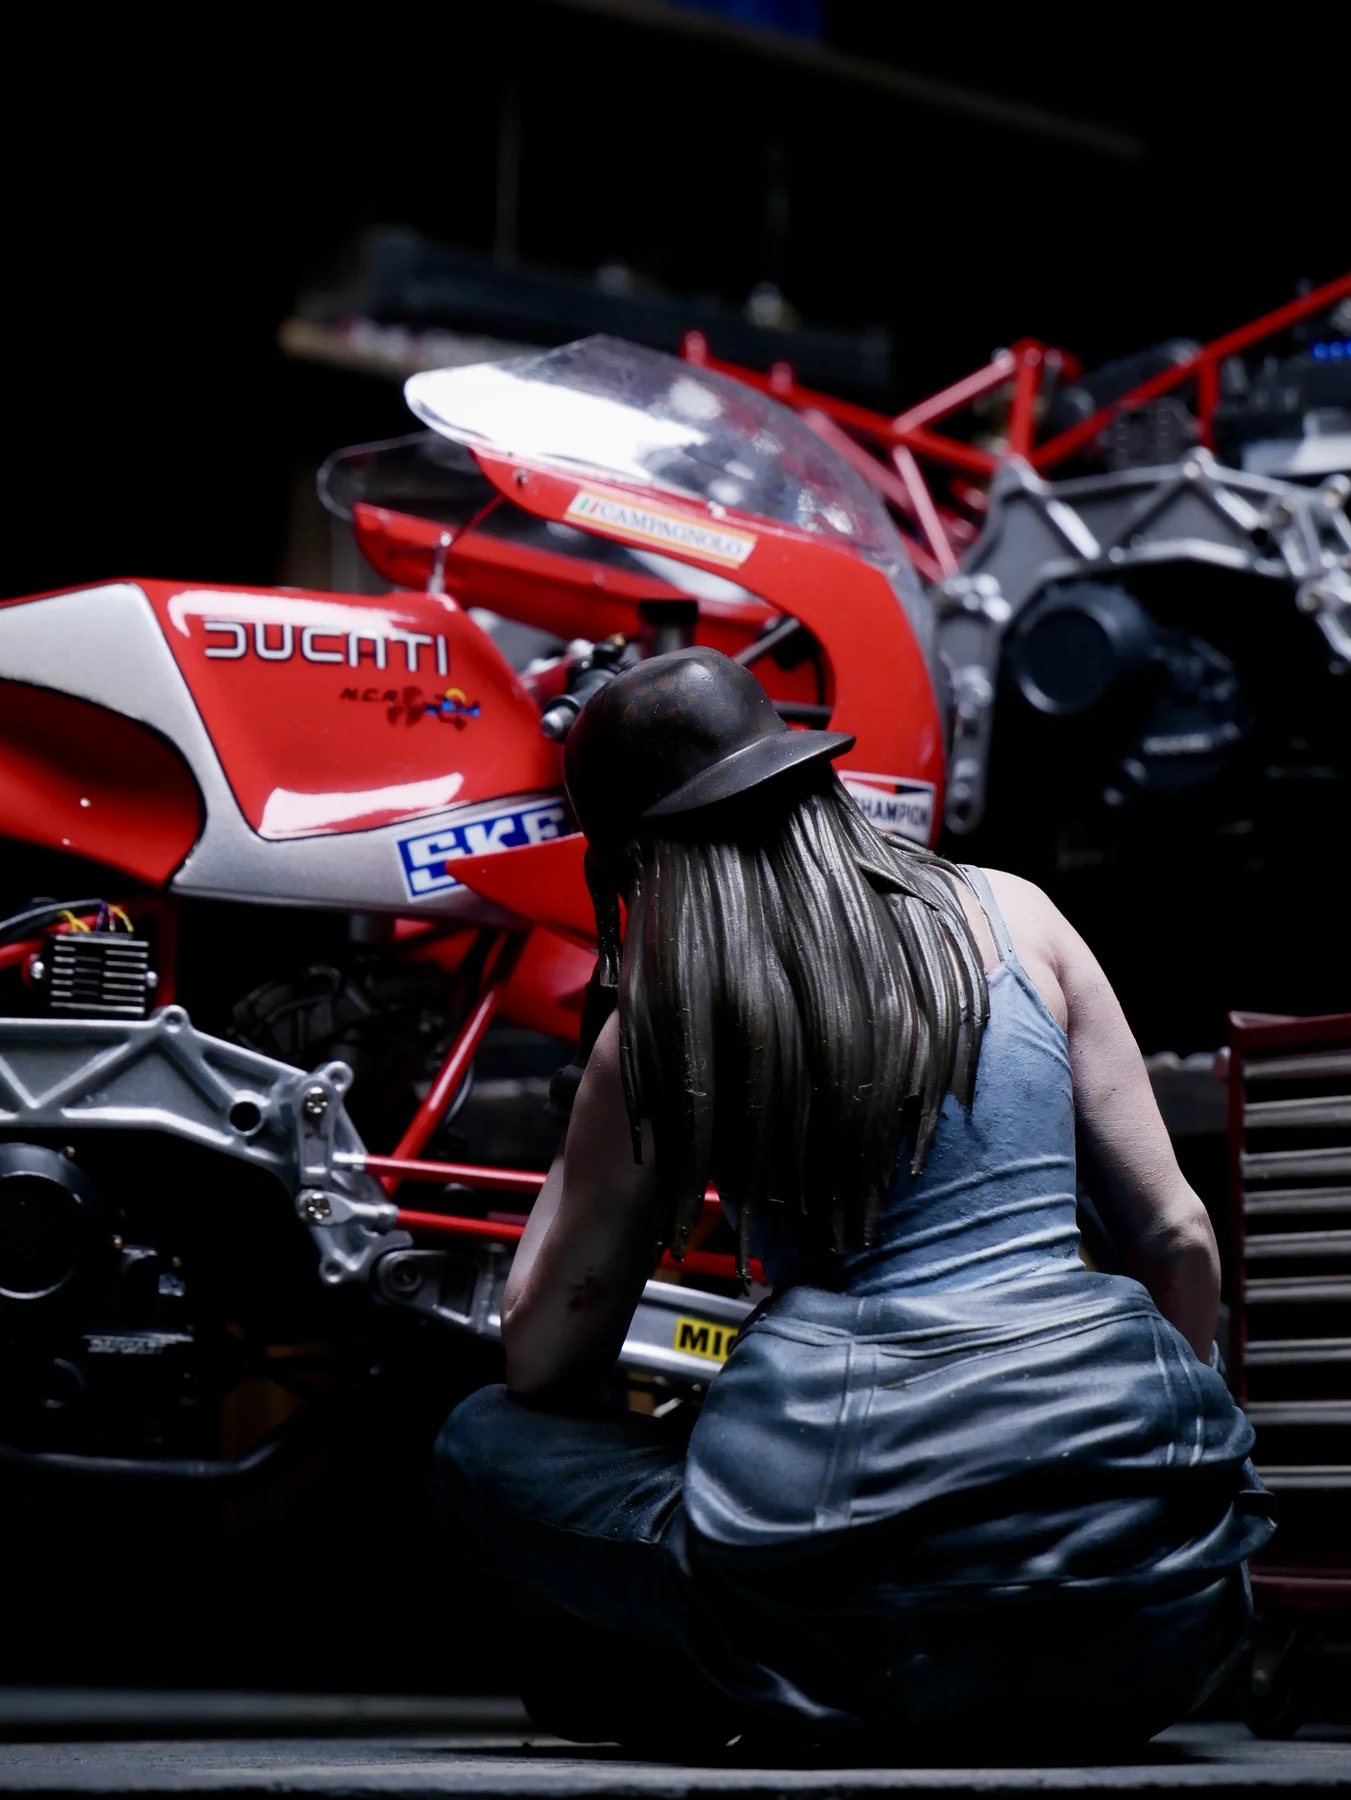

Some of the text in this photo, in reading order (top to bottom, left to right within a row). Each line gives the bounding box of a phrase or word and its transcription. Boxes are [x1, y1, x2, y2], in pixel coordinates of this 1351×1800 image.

[600, 503, 742, 554] CAMPAGNOLO
[204, 621, 449, 676] DUCATI
[407, 808, 564, 892] SKF
